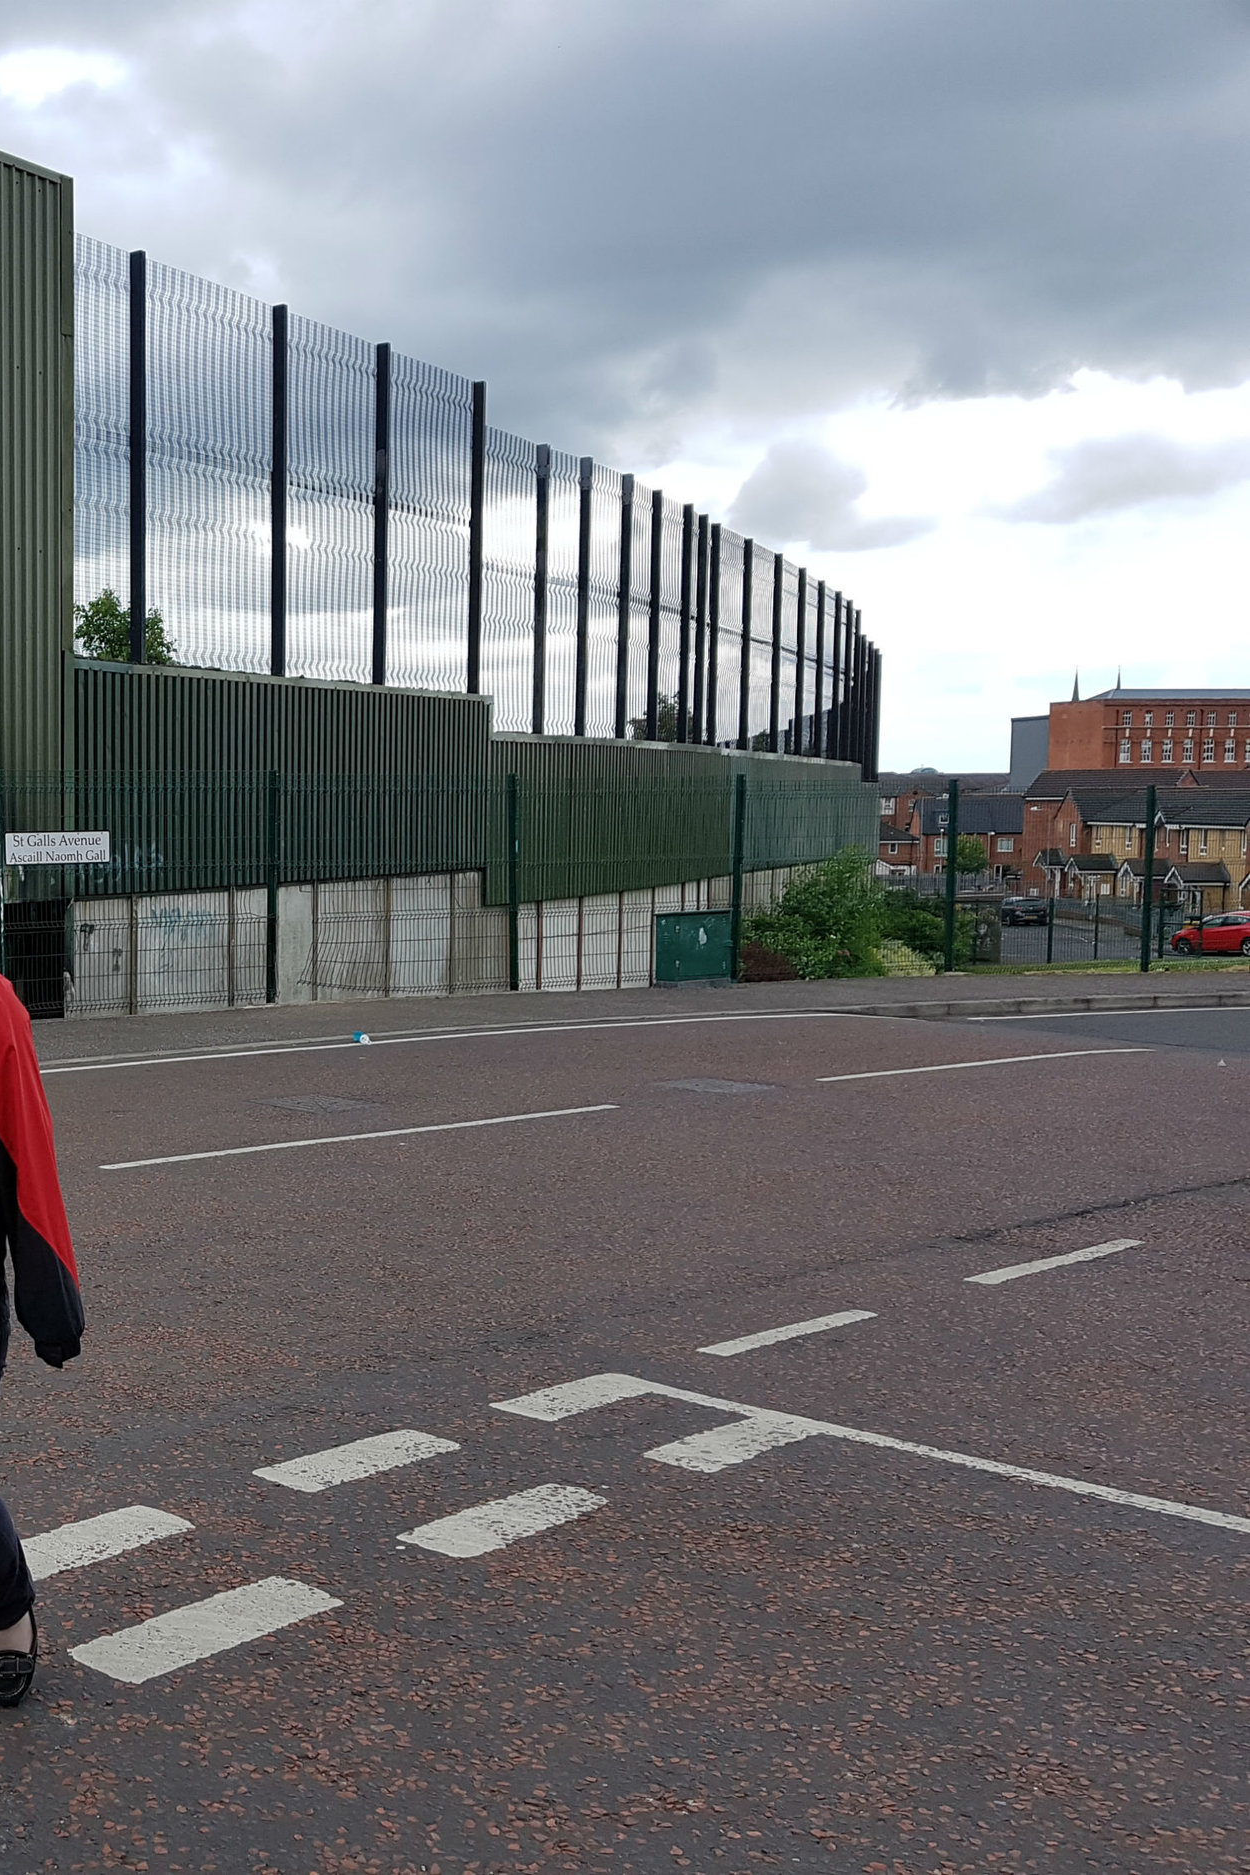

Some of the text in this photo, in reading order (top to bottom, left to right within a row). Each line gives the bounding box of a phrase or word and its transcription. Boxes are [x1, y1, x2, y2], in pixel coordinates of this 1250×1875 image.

[13, 834, 101, 847] St Galls Avenue
[9, 849, 106, 863] Ascaill Naomh Gall
